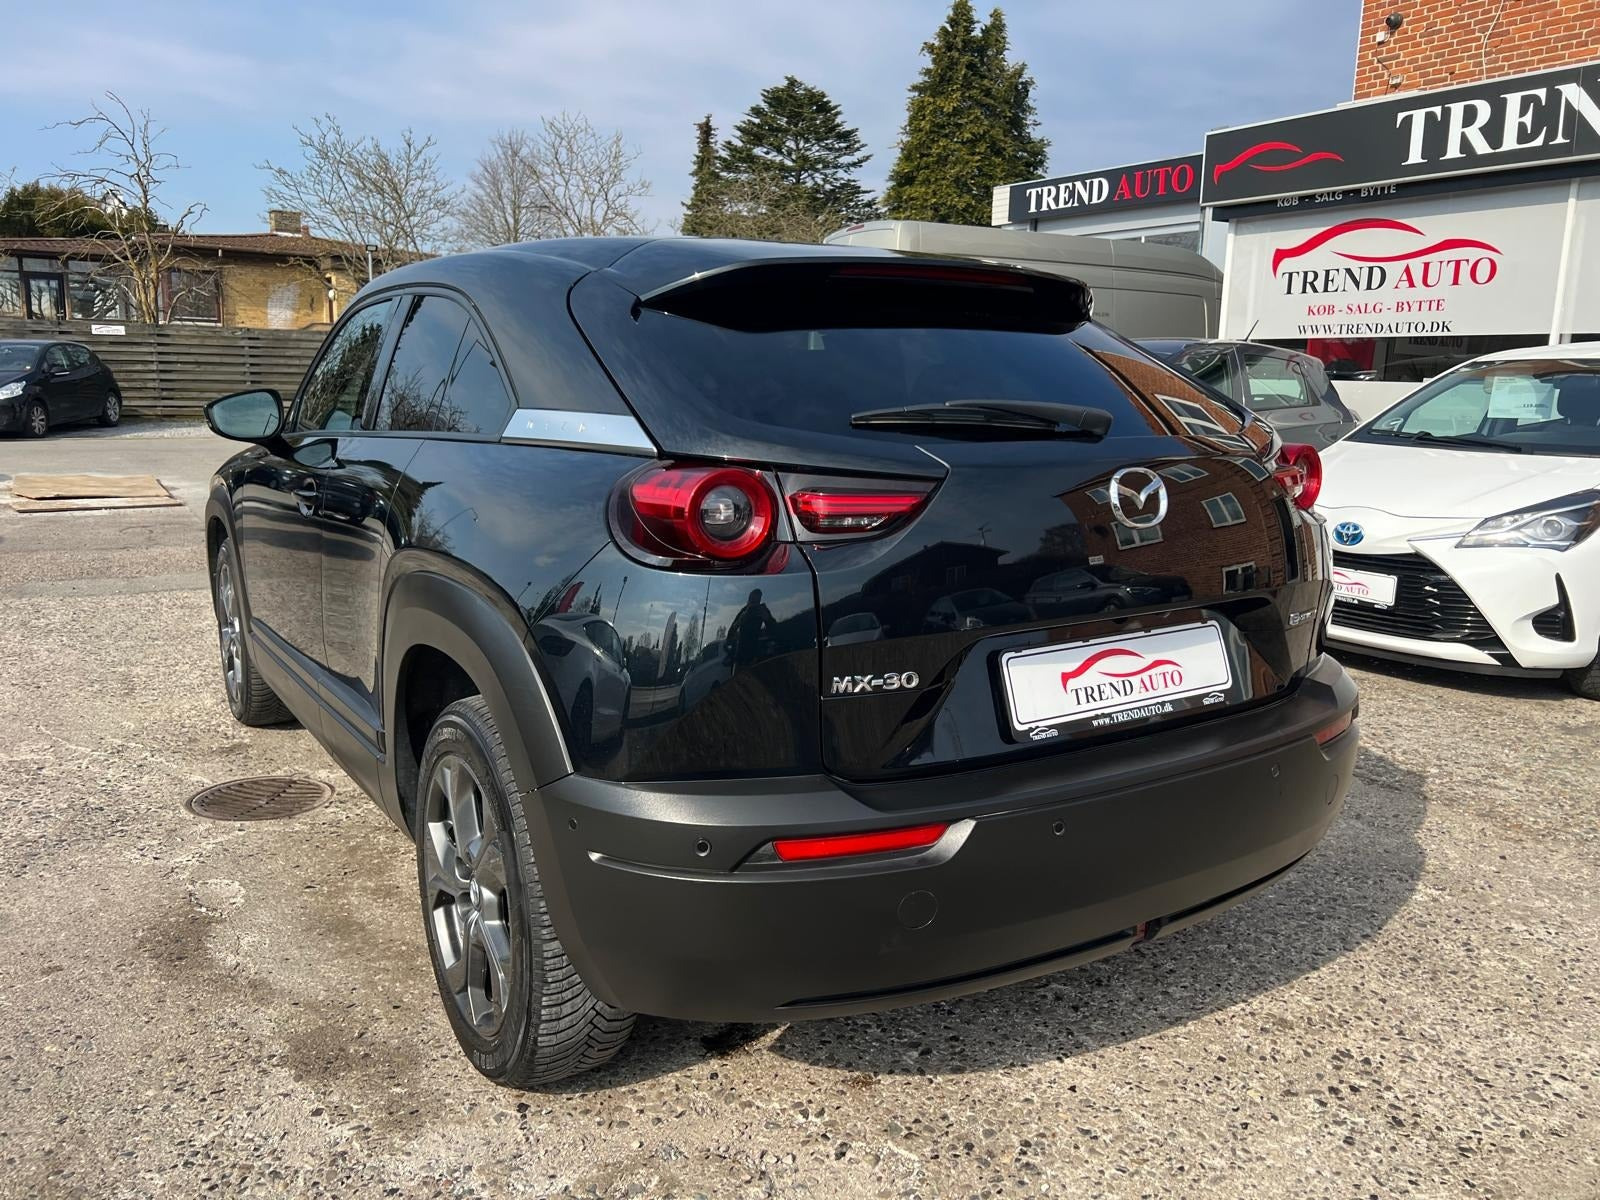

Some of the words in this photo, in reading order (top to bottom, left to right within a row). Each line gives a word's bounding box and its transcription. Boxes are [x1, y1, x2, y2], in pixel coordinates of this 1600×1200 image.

[1396, 79, 1600, 165] TREN
[1026, 177, 1109, 213] TREND
[1113, 163, 1194, 201] AUTO
[1276, 196, 1299, 207] KØB
[1315, 191, 1343, 203] SALG
[1360, 183, 1397, 197] BYTTE
[1282, 265, 1387, 295] TREND
[1394, 256, 1498, 289] AUTO
[1307, 304, 1335, 317] KØB
[1345, 301, 1384, 315] SALG
[1395, 298, 1446, 314] BYTTE
[1297, 320, 1452, 336] WWW.TRENDAUTO.DK
[831, 671, 919, 693] MX-30
[1071, 678, 1134, 706] TREND
[1138, 669, 1183, 694] AUTO
[1091, 702, 1173, 727] www.TRENDAUTO.dk
